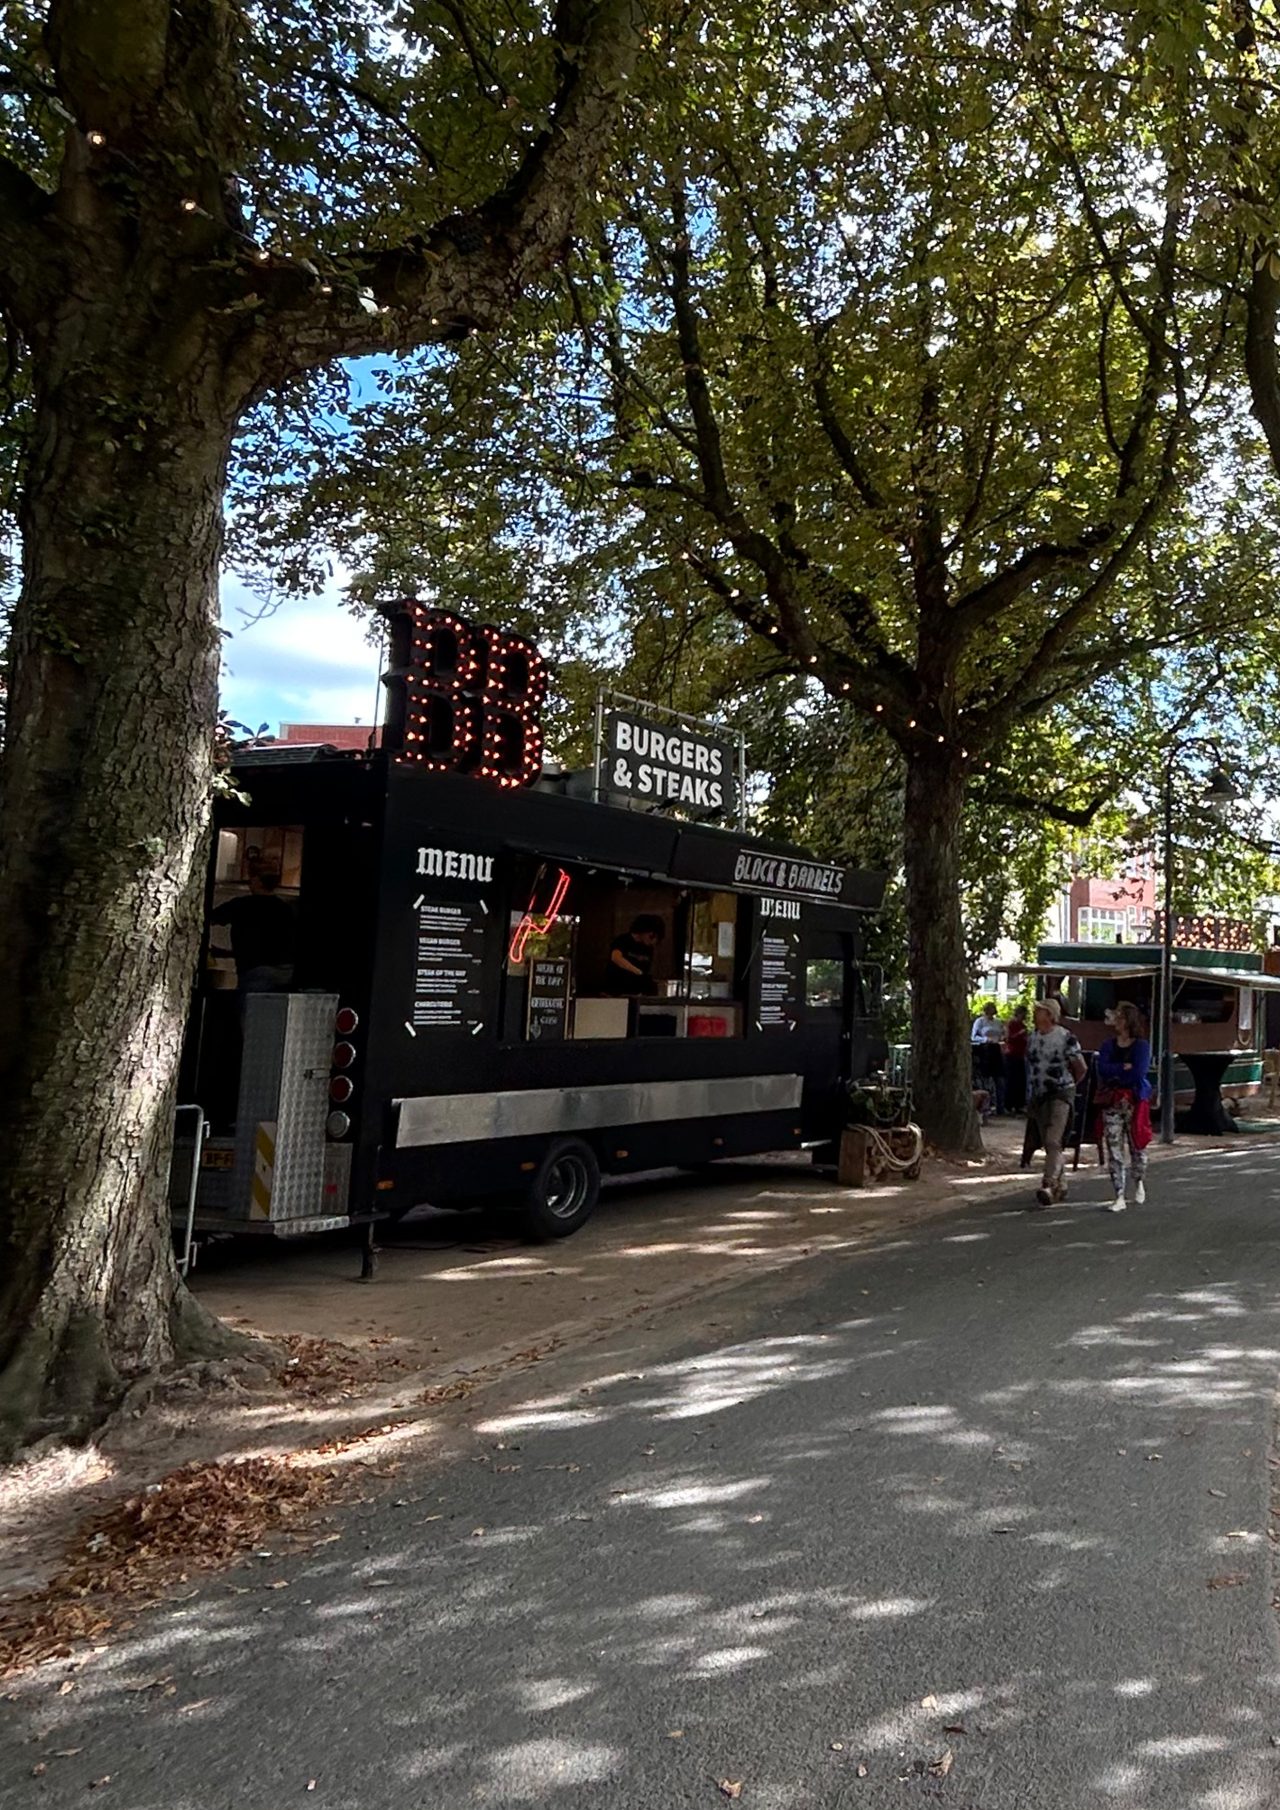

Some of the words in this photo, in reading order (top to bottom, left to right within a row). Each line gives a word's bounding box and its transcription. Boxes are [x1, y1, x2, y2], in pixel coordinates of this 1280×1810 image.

[385, 599, 548, 788] BB
[616, 720, 723, 776] BURGERS
[613, 761, 633, 789] &
[637, 763, 723, 808] STEAKS
[416, 847, 495, 882] MENU
[735, 855, 777, 883] BLOCK
[776, 862, 788, 887] &
[788, 865, 844, 893] BARRELS
[760, 897, 801, 920] MENU
